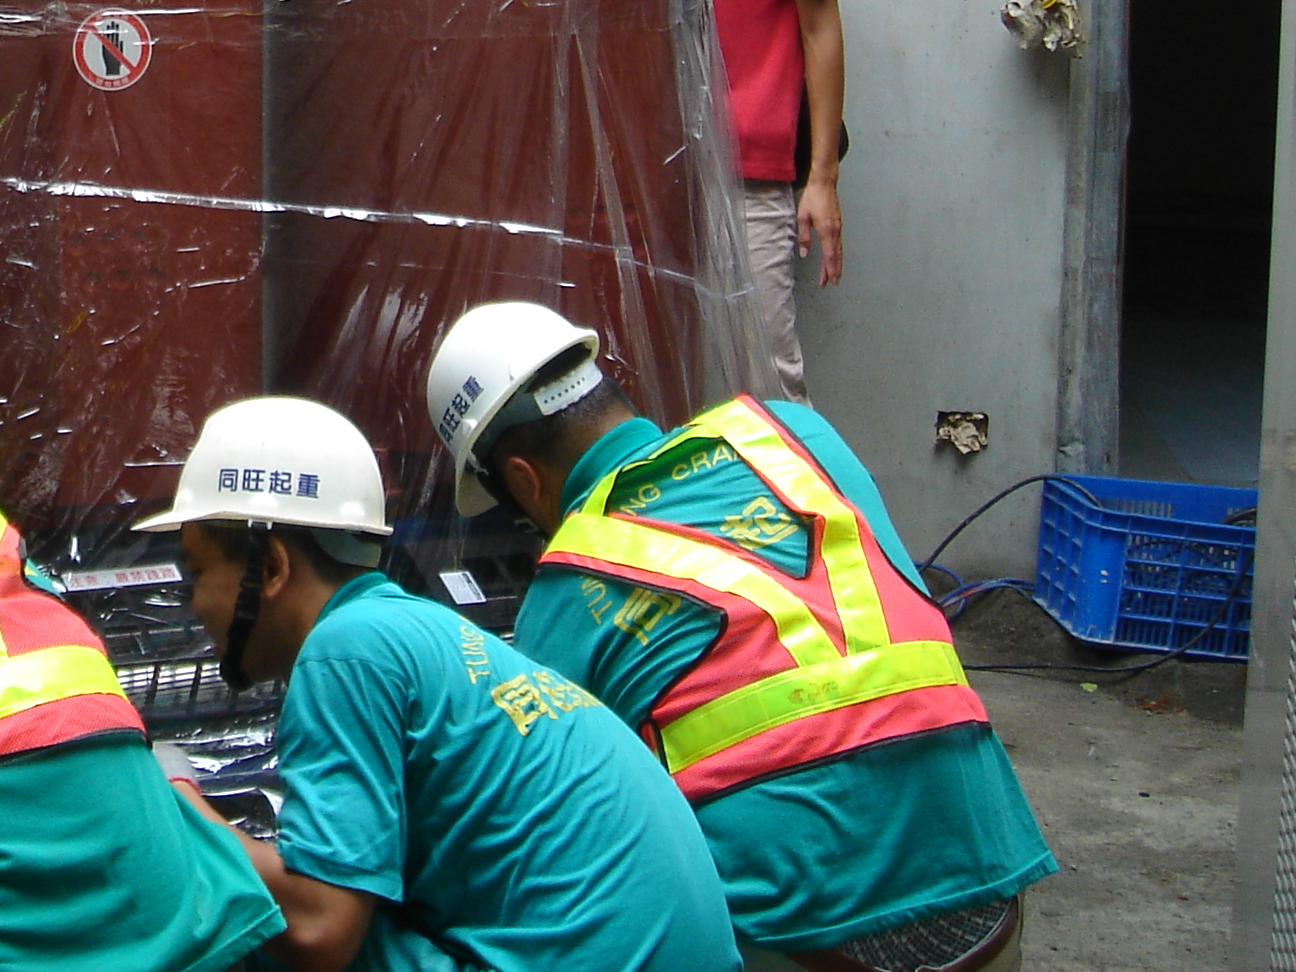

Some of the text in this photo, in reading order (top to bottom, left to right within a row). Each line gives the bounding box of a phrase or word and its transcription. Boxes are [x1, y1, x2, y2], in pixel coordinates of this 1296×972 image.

[670, 442, 742, 482] CRA
[217, 468, 322, 500] 同旺起重
